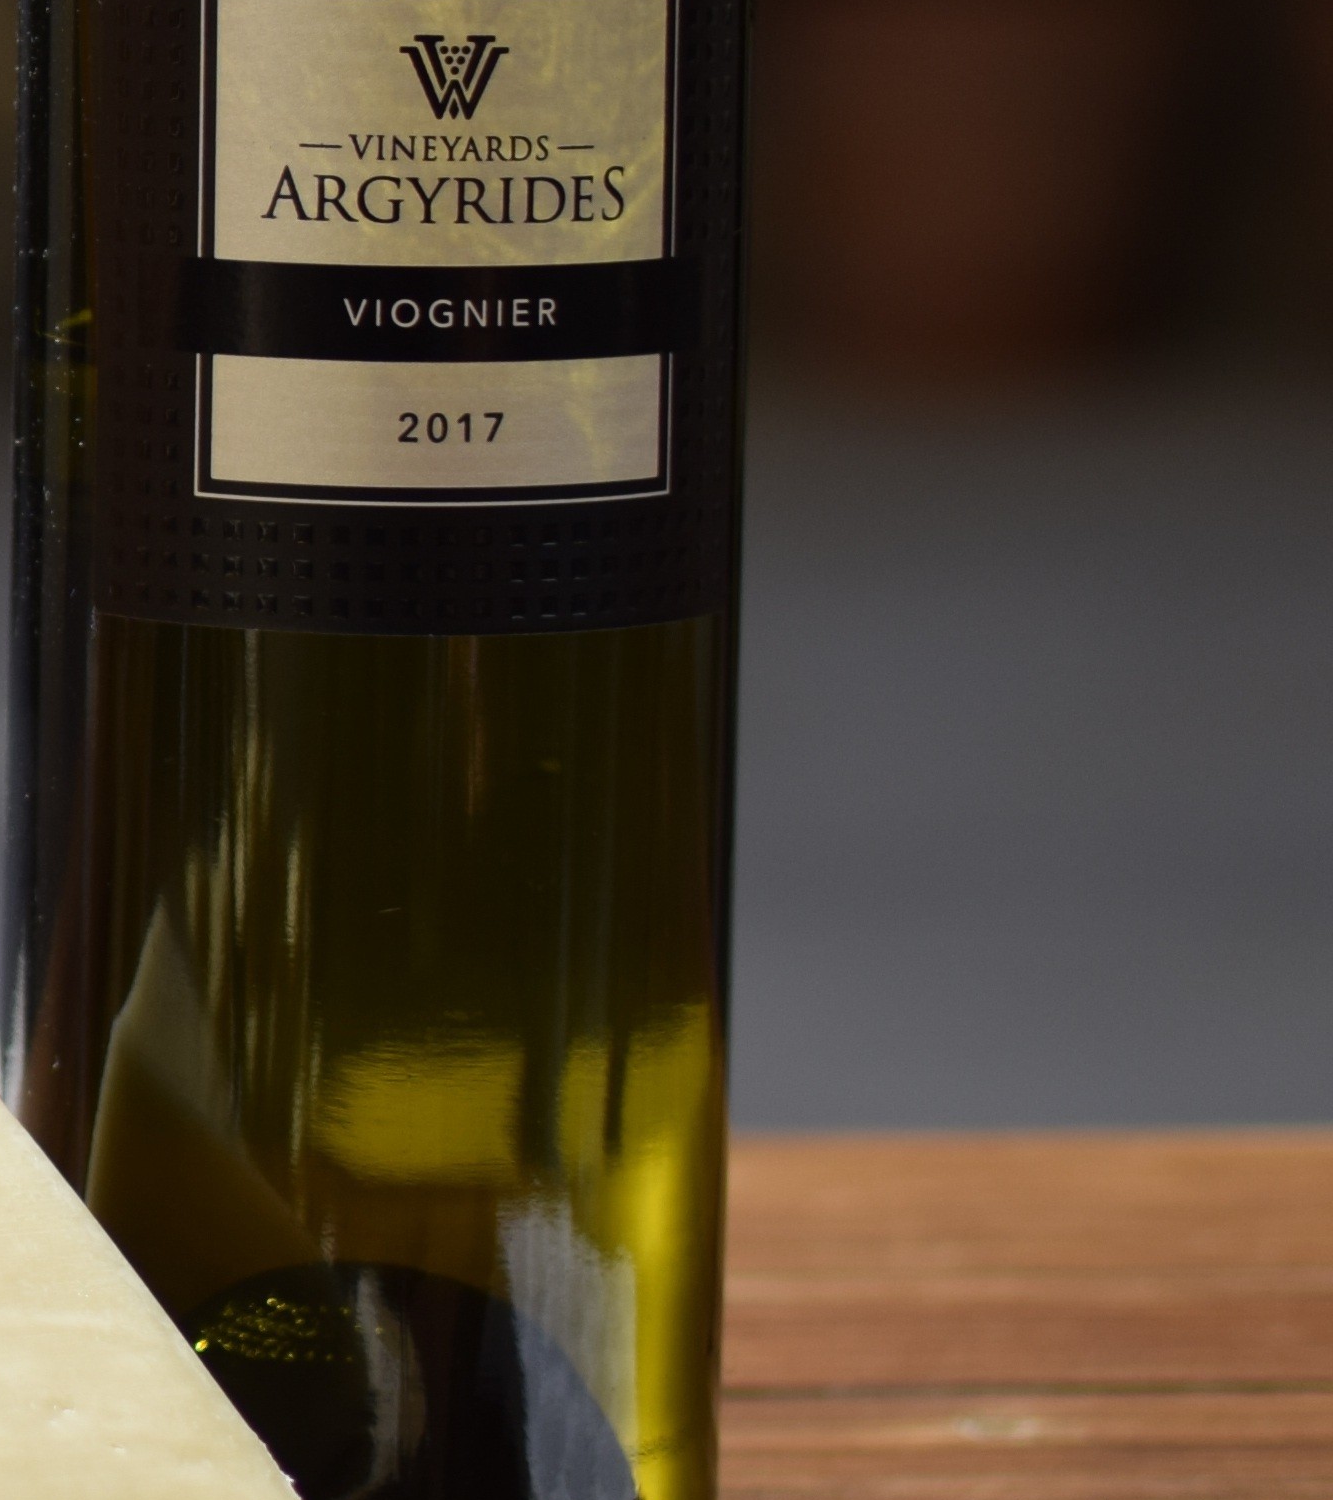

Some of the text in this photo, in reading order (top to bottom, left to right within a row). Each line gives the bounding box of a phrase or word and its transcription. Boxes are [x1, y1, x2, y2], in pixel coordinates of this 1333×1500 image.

[348, 133, 550, 162] VINEYARDS
[261, 165, 626, 225] ARGYRIDES
[343, 298, 557, 328] VIOGNIER
[397, 412, 505, 444] 2017
